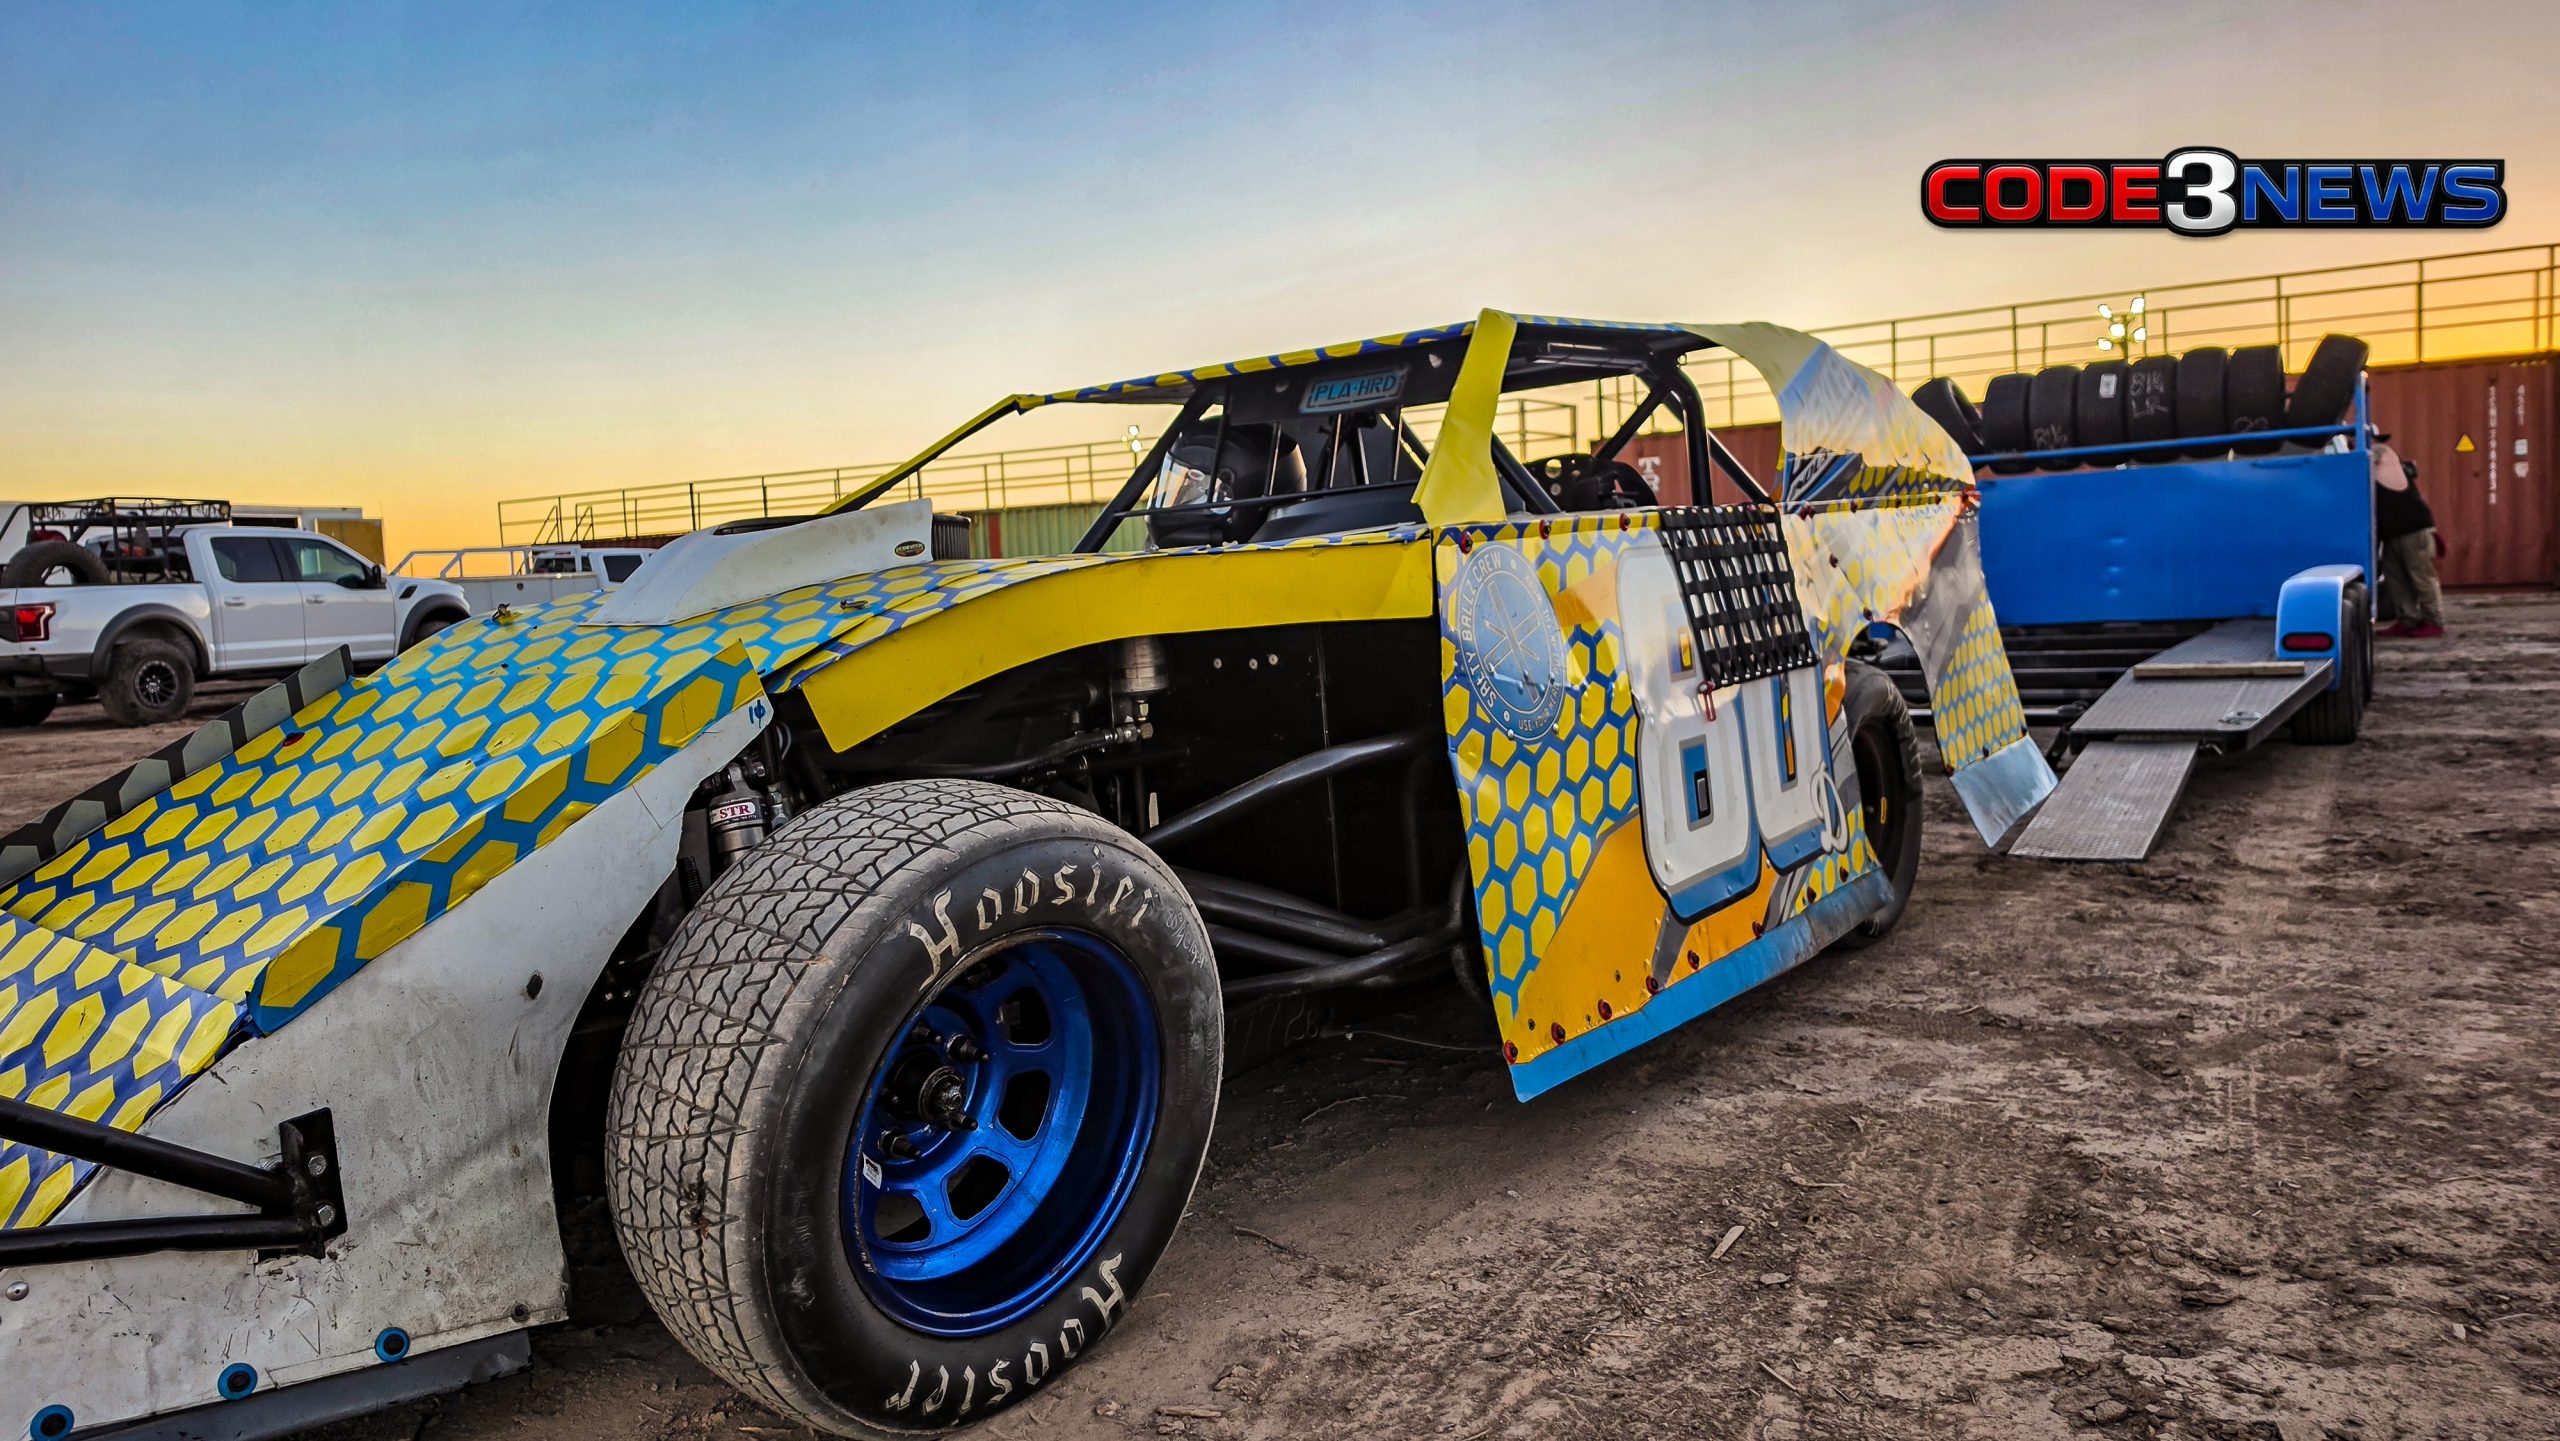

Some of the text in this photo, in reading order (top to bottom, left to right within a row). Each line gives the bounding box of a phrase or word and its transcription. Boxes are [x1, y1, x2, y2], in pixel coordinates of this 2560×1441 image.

[1462, 551, 1502, 708] SALTY BALLZ CREW
[1518, 716, 1534, 732] USE
[1535, 708, 1551, 728] YOUR
[719, 804, 751, 819] STR
[908, 843, 1160, 991] Hoosier
[886, 1252, 1125, 1425] Hoosier
